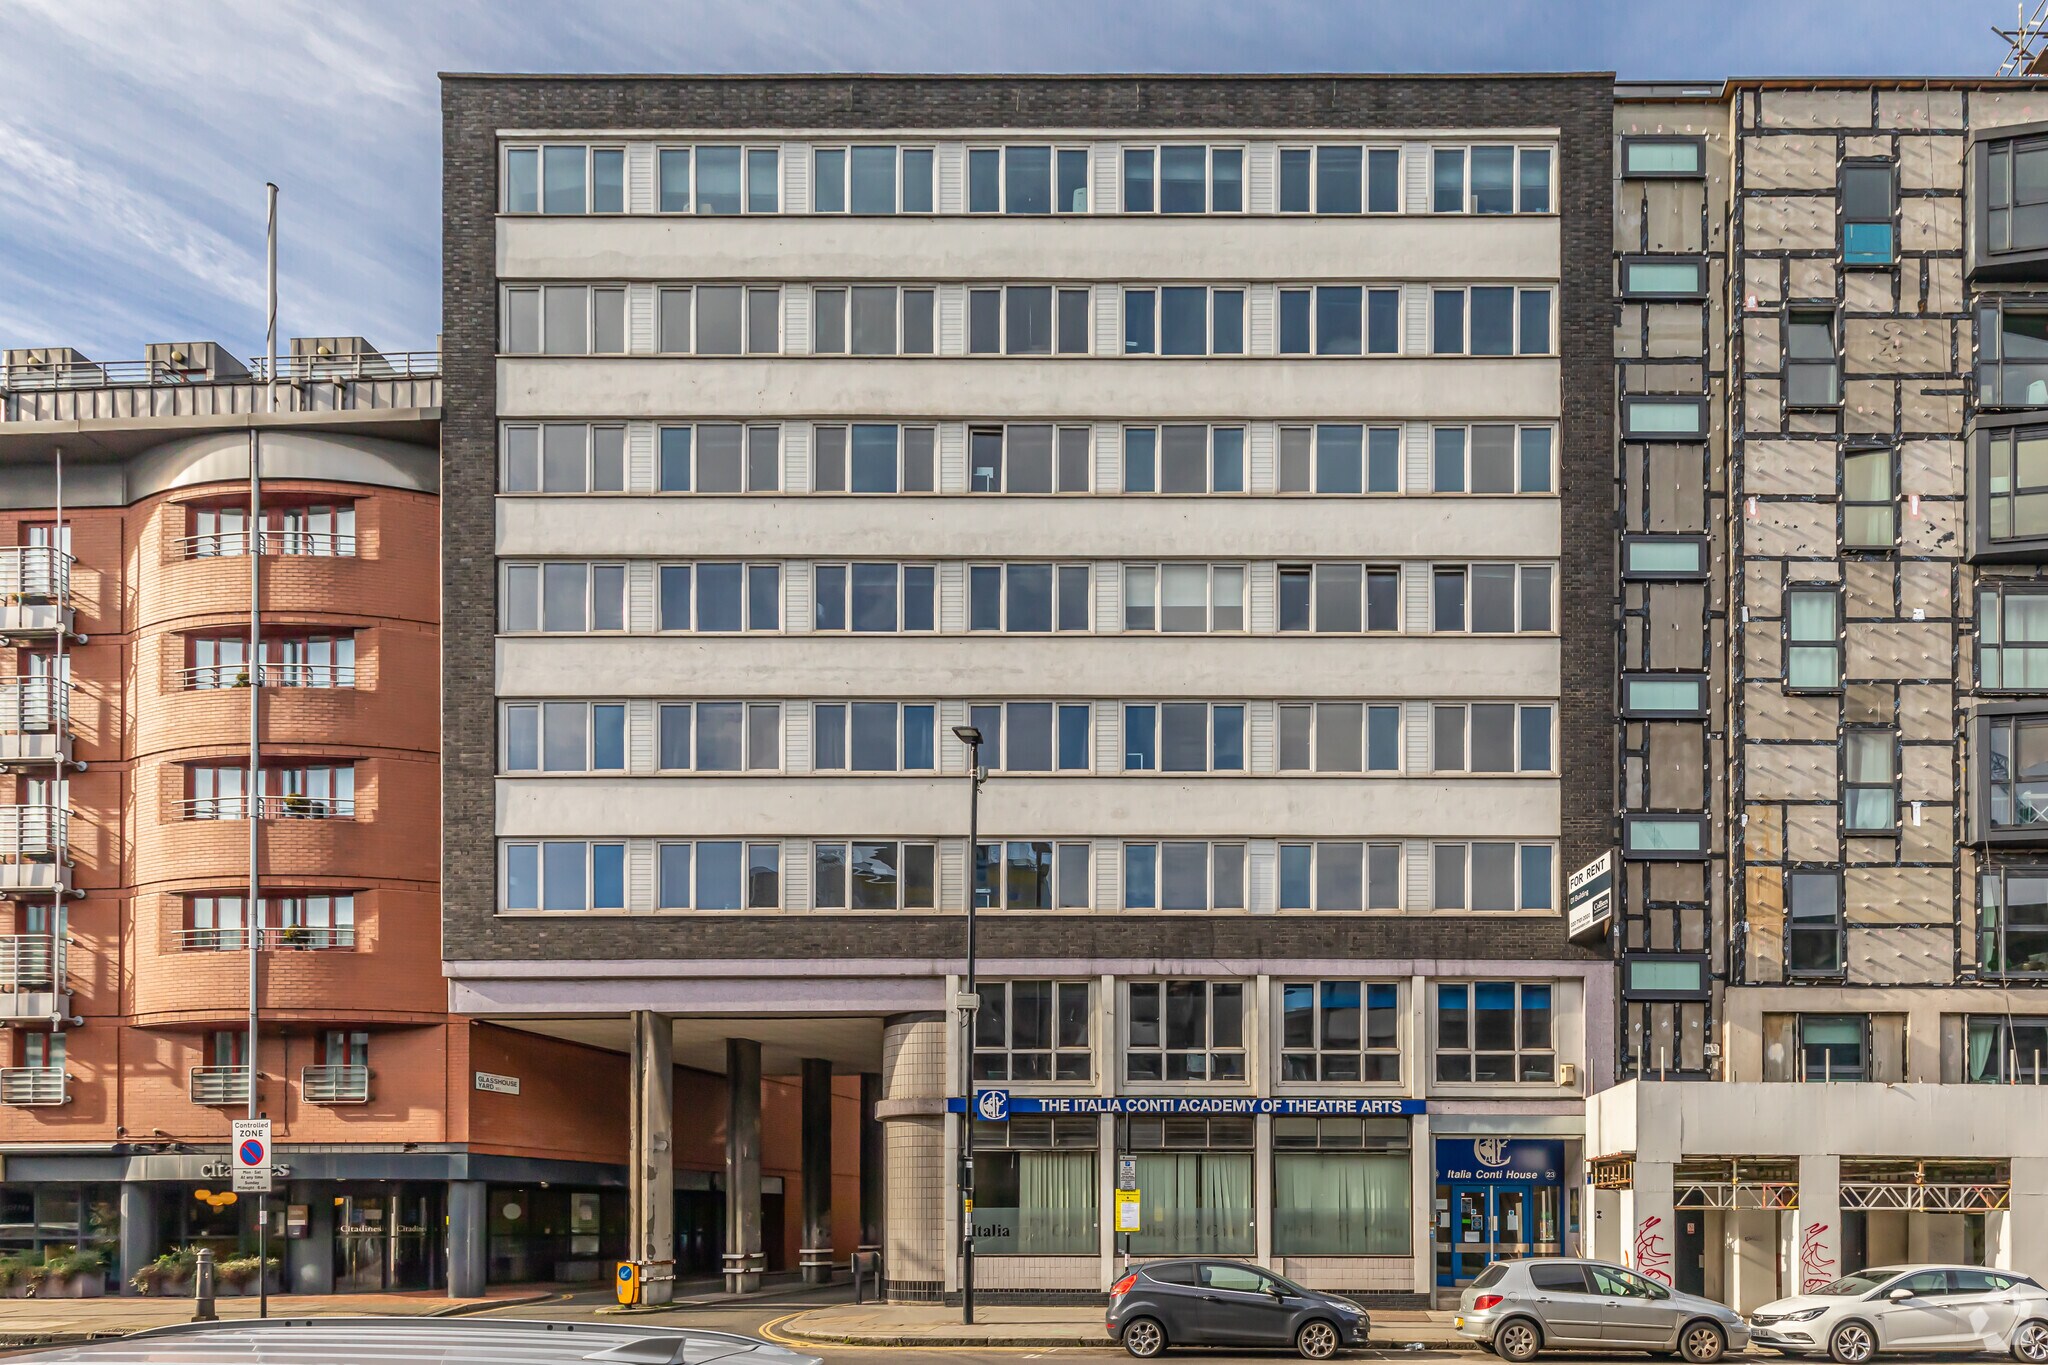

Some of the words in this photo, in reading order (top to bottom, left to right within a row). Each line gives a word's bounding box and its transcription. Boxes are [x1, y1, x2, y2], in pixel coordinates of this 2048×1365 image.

[1570, 873, 1584, 889] FOR
[1586, 859, 1605, 879] RENT
[478, 1076, 517, 1087] GLASSHOUSE
[1039, 1099, 1070, 1112] THE
[1074, 1099, 1122, 1112] ITALIA
[1125, 1099, 1175, 1112] CONTI
[1178, 1099, 1257, 1112] ACADEMY
[1261, 1099, 1282, 1112] OF
[1286, 1100, 1357, 1113] THEATRE
[1360, 1100, 1402, 1113] ARTS
[201, 1159, 290, 1177] citaes
[1447, 1170, 1472, 1179] Italia
[1475, 1170, 1503, 1179] Conti
[1506, 1170, 1538, 1179] House
[1545, 1171, 1556, 1179] 23
[340, 1225, 382, 1233] Citadines
[972, 1224, 1010, 1237] Italia
